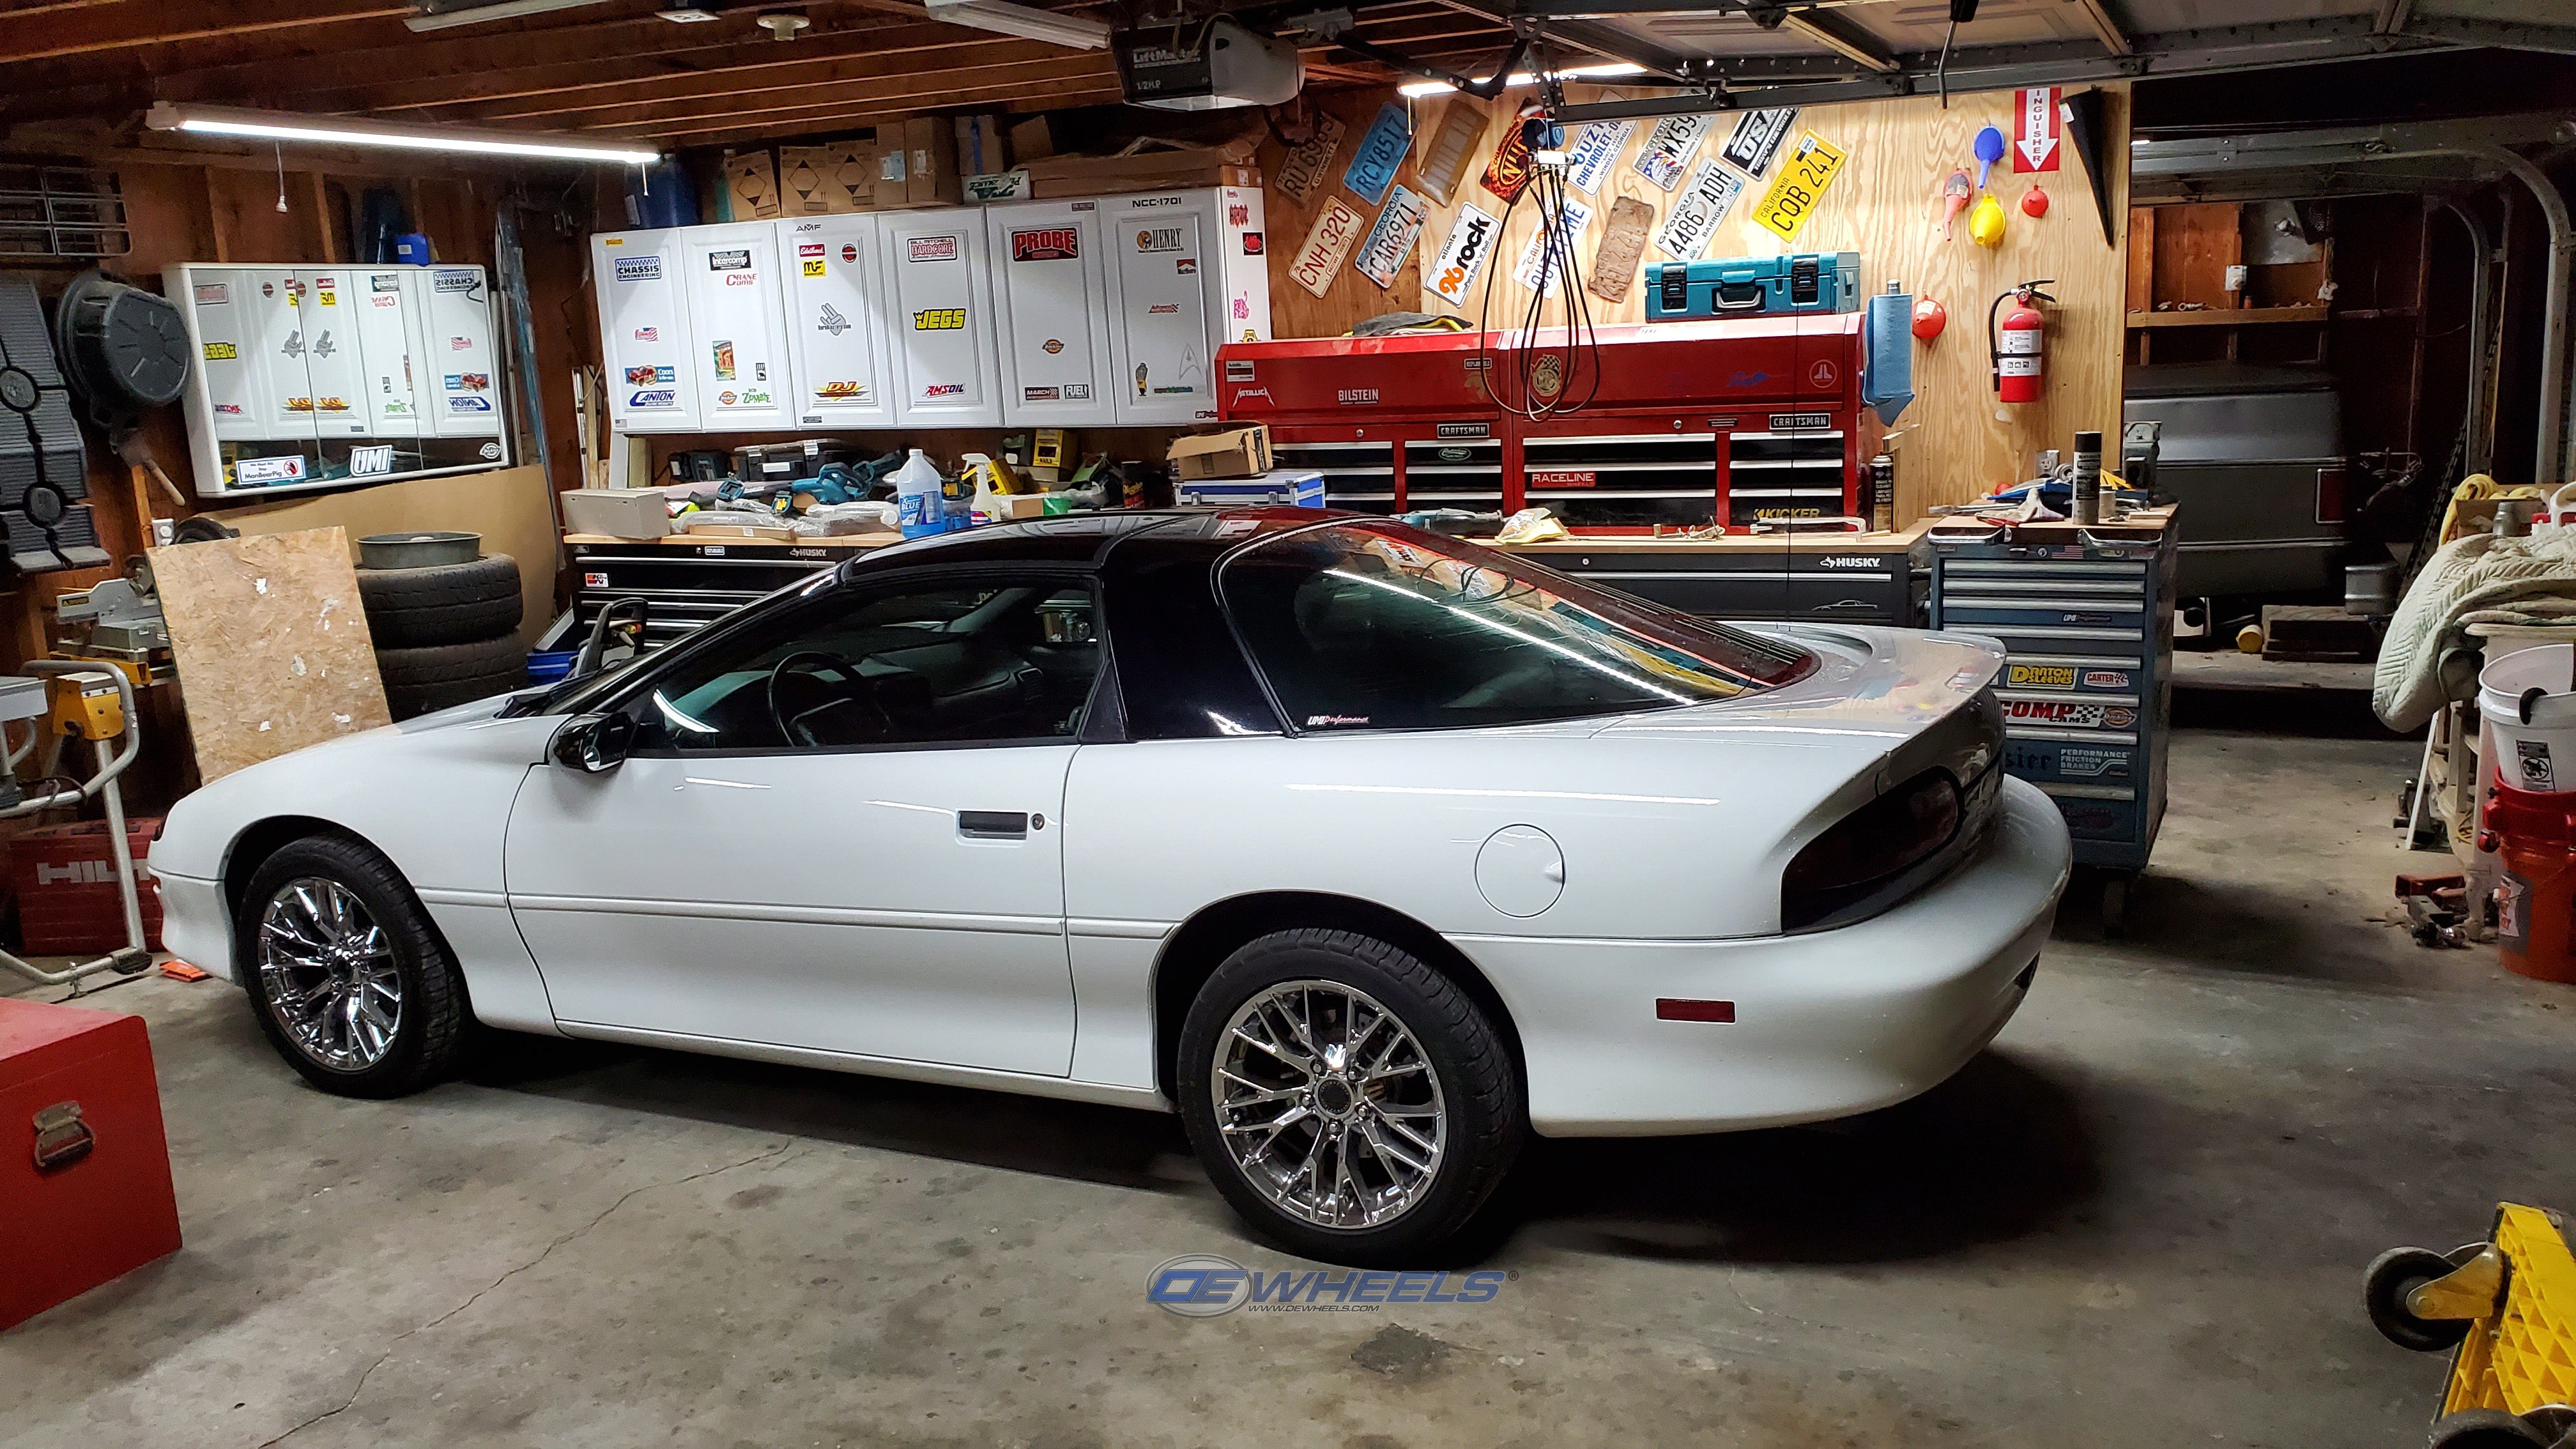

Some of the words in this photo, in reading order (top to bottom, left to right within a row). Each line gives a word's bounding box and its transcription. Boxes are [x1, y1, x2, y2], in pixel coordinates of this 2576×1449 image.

[2032, 88, 2043, 162] INGUISHER
[1613, 127, 1630, 152] GEORGIA
[1354, 114, 1407, 192] RCY8517
[1314, 146, 1335, 185] GWINNETT
[1769, 183, 1813, 234] CQB
[1798, 144, 1838, 188] 241
[1760, 176, 1790, 218] CALIFORNIA
[1373, 192, 1403, 237] GEORGIA
[1657, 190, 1694, 245] GEORGIA
[1665, 209, 1705, 257] 4486
[1698, 167, 1733, 206] ADH
[1702, 203, 1725, 238] BARROW
[1014, 231, 1077, 259] PROBE
[1152, 228, 1182, 249] HENRY
[1368, 201, 1418, 275] CAR6971
[911, 243, 953, 256] HARDCORE
[1298, 243, 1332, 288] CNH
[1319, 205, 1353, 247] 320
[1441, 233, 1457, 260] atlanta
[712, 256, 747, 266] Intercomp
[1471, 260, 1481, 274] Rock
[618, 265, 660, 274] CHASSIS
[1294, 264, 1301, 273] 76
[726, 273, 757, 286] CRANE
[916, 309, 965, 329] JEGS
[826, 381, 857, 392] DJ
[924, 383, 965, 396] AMSOIL
[629, 390, 676, 407] CANTON
[1338, 388, 1379, 401] BILSTEIN
[1440, 426, 1487, 436] CRAFTSMAN
[353, 447, 390, 473] UMI
[245, 470, 283, 479] ManBearPig
[1532, 473, 1594, 483] RACELINE
[1765, 508, 1821, 518] KICKER
[799, 549, 827, 557] HUSKY
[1836, 557, 1881, 567] HUSKY
[2087, 673, 2114, 682] CARTER
[1307, 716, 1326, 725] UMI
[2060, 749, 2128, 758] PERFORMANCE
[2060, 756, 2101, 764] FRICTION
